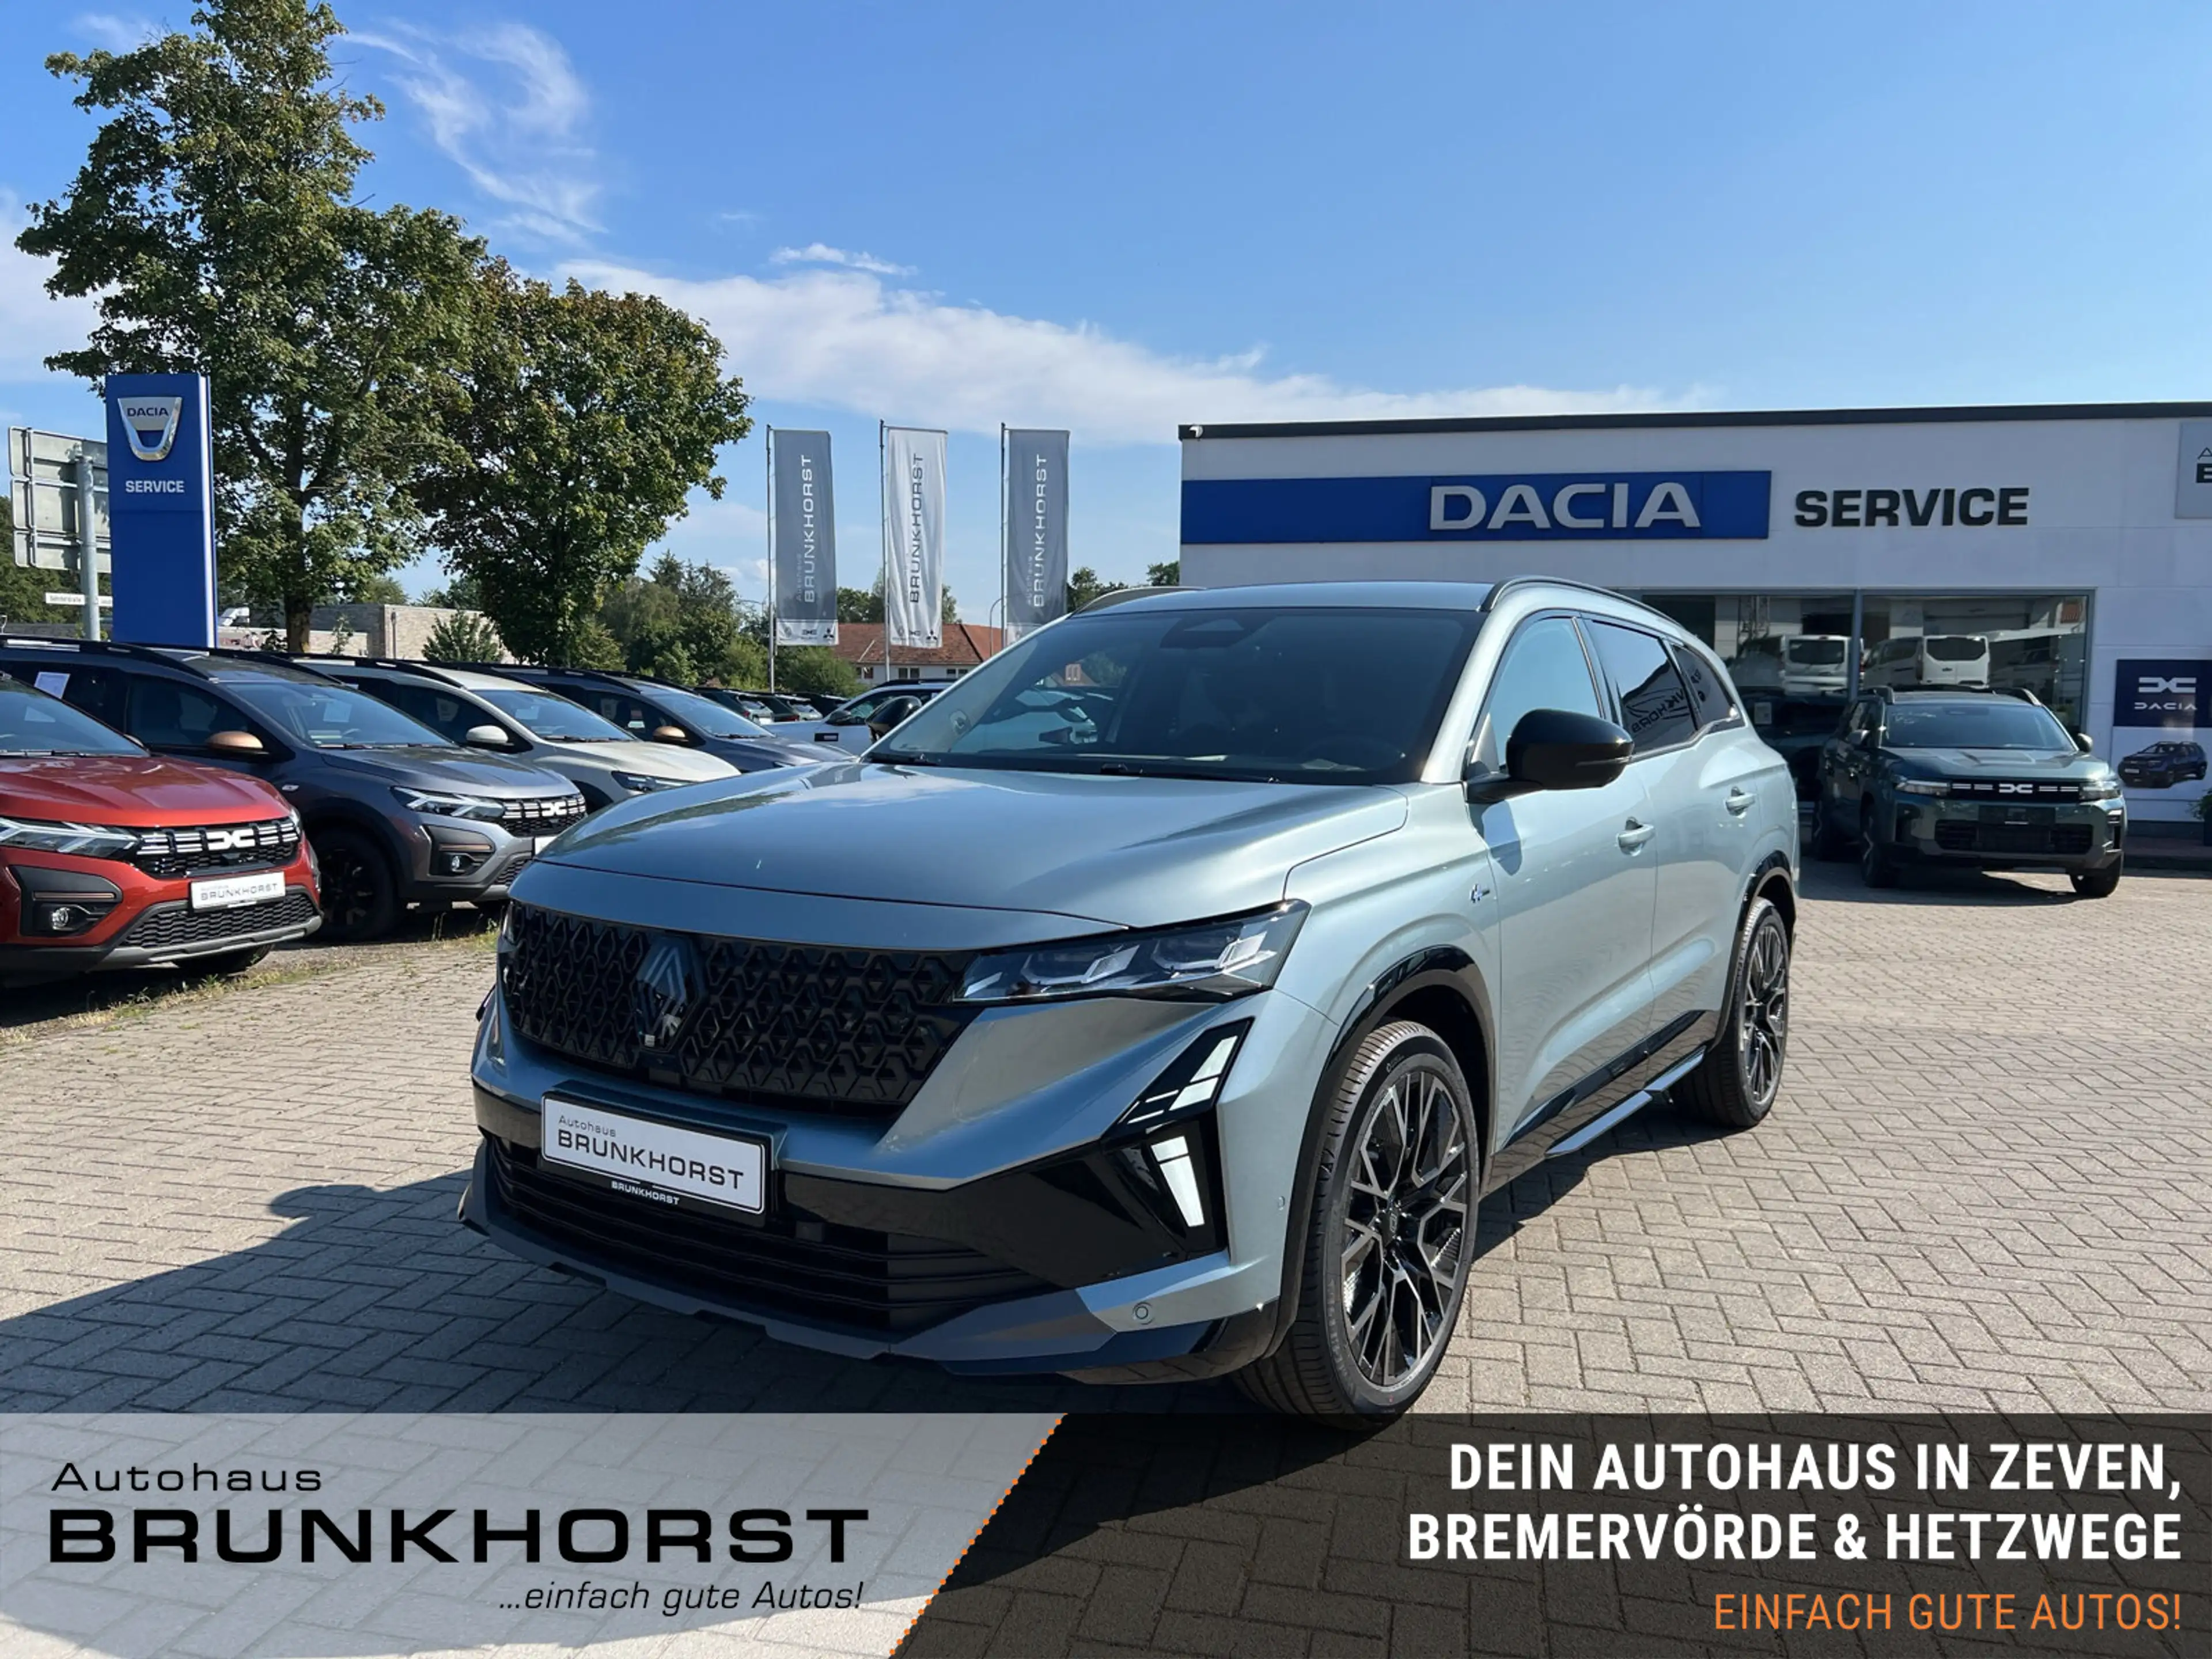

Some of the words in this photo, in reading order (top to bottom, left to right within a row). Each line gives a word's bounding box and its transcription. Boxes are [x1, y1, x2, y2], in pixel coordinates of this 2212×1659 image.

[127, 408, 169, 416] DACIA
[125, 480, 185, 493] SERVICE
[1430, 482, 1701, 530] DACIA
[1794, 487, 2029, 527] SERVICE
[801, 454, 815, 603] BRUNKHORST
[910, 453, 924, 603] BRUNKHORST
[1034, 454, 1047, 607] BRUNKHORST
[2134, 702, 2198, 710] DACIA
[201, 883, 278, 900] BRUNKHORST
[559, 1115, 616, 1137] Autohaus
[558, 1129, 744, 1190] BRUNKHORST
[611, 1181, 680, 1206] BRUNKHORST
